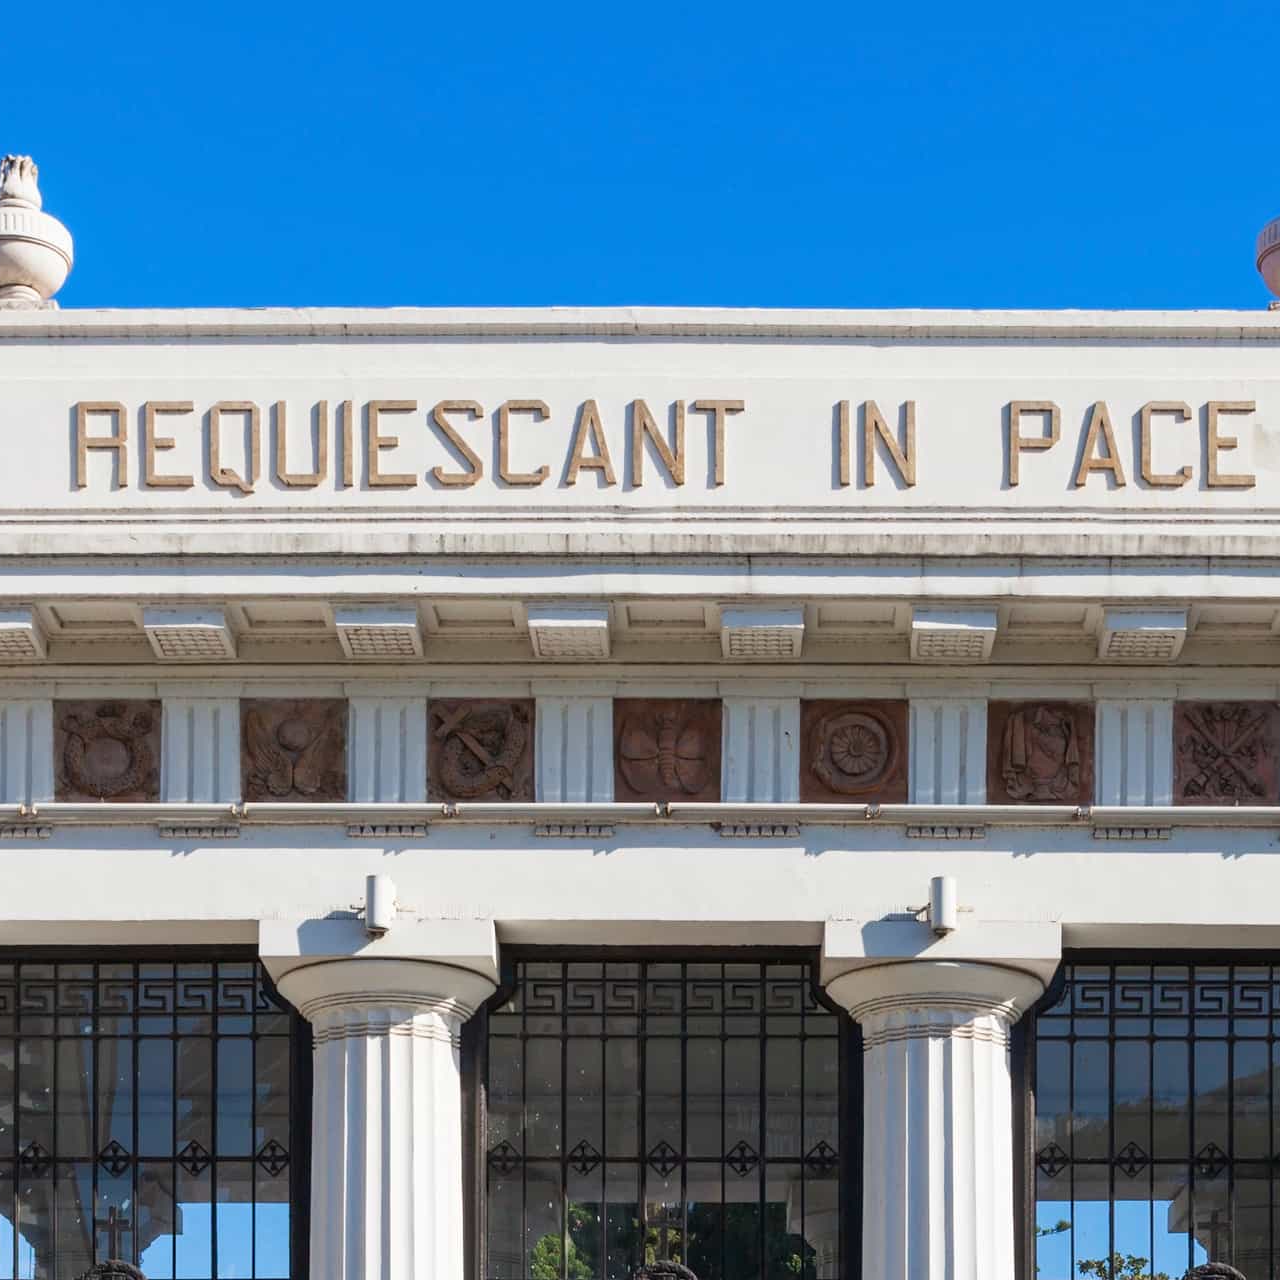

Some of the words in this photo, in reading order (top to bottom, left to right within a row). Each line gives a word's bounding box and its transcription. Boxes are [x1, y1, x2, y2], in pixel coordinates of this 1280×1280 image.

[76, 400, 745, 494] REQUIESCANT
[839, 400, 916, 488] IN
[1009, 400, 1257, 488] PACE
